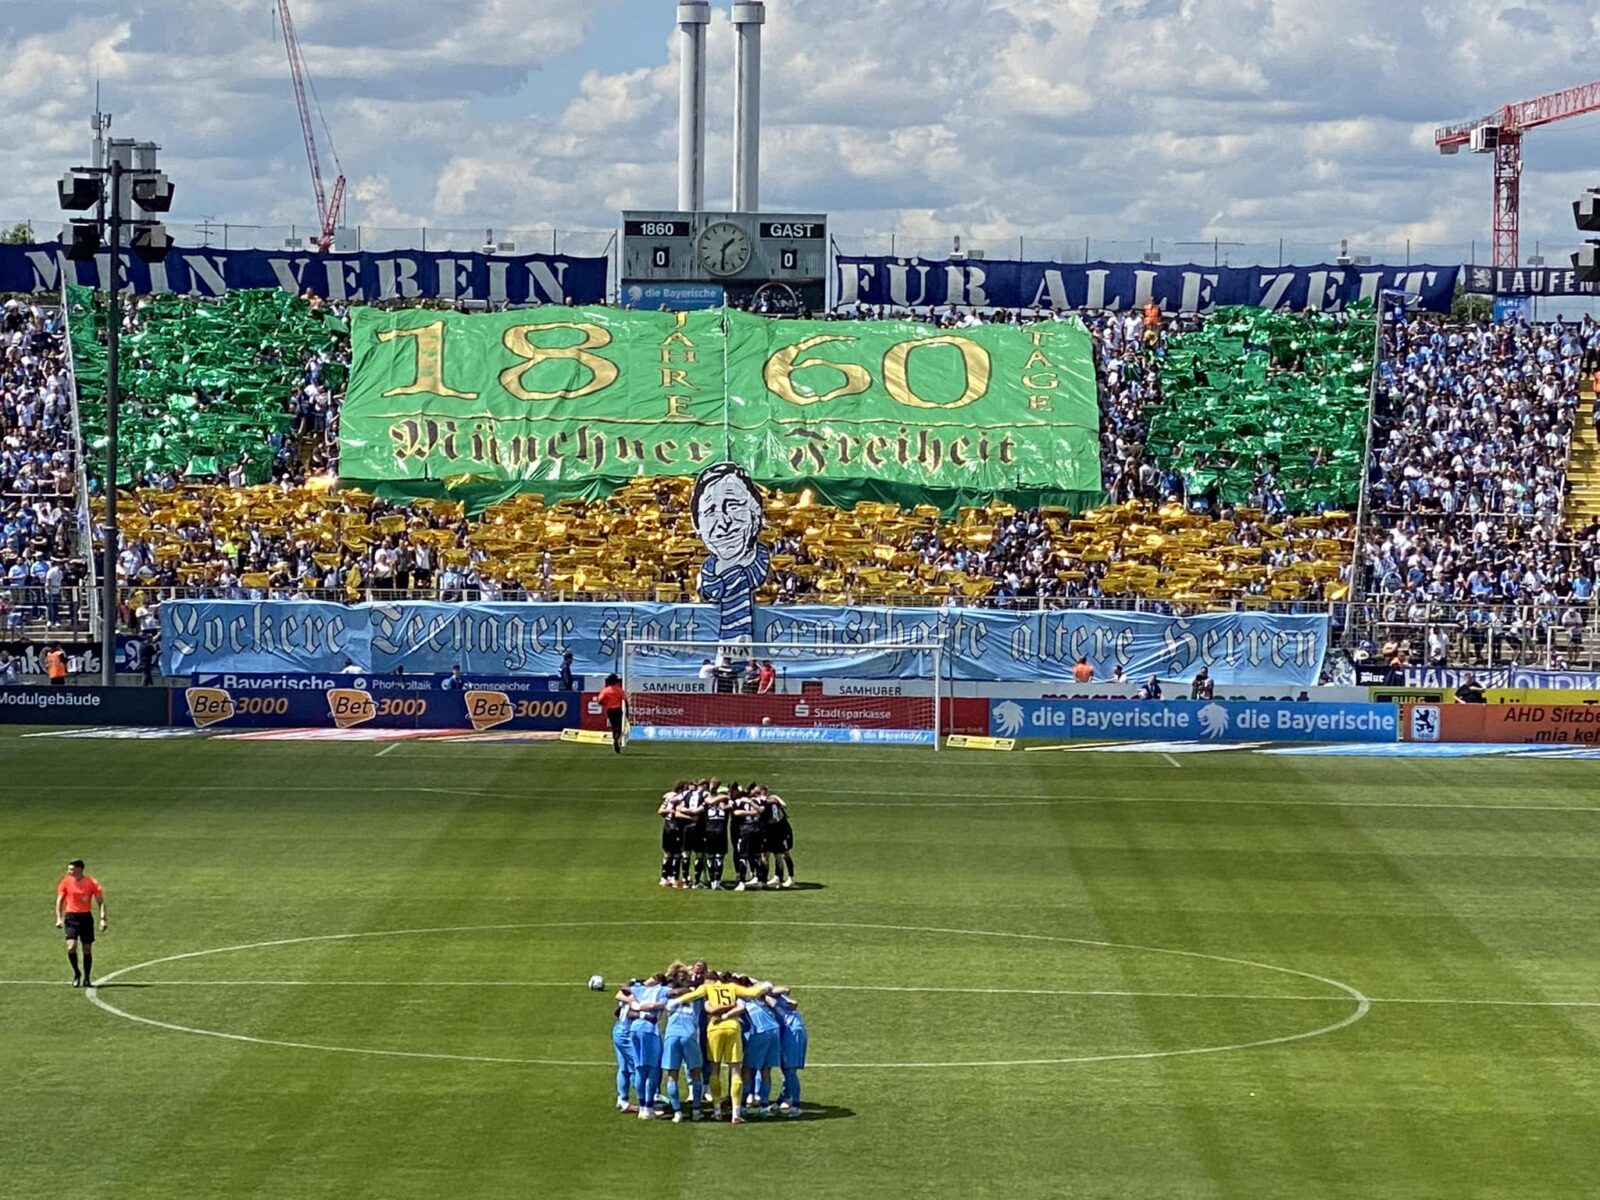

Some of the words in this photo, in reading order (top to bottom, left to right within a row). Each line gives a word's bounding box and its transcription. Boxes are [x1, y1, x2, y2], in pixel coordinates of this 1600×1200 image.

[640, 223, 674, 236] 1860
[770, 224, 814, 238] GAST
[656, 252, 665, 266] 0
[784, 253, 793, 268] 0
[25, 250, 227, 297] MEIN
[267, 257, 568, 302] VEREIN
[838, 258, 990, 307] FÜR
[1028, 269, 1219, 313] ALLE
[1258, 271, 1437, 313] ZEIT
[645, 287, 661, 298] die
[663, 288, 717, 300] Bayerische
[376, 319, 620, 401] 18
[658, 311, 699, 418] JAHRE
[762, 334, 993, 409] 60
[1020, 329, 1059, 411] TAGE
[388, 418, 713, 469] Münchner
[784, 427, 1016, 475] Freiheit
[170, 602, 346, 656] Lockere
[370, 603, 575, 671] Teenager
[1011, 611, 1134, 665] ältere
[1163, 617, 1320, 678] Herren
[642, 682, 706, 693] SAMHUBER
[839, 685, 902, 696] SAMHUBER
[193, 695, 229, 714] Bet
[236, 697, 289, 715] 3000
[335, 696, 371, 715] Bet
[377, 698, 427, 716] 3000
[473, 698, 508, 716] Bet
[515, 700, 567, 718] 3000
[814, 708, 891, 721] Stadtsparkasse
[1503, 707, 1545, 722] AHD
[1031, 707, 1065, 727] die
[1072, 708, 1189, 733] Bayerische
[1236, 710, 1270, 729] die
[1277, 710, 1395, 736] Bayerische
[714, 988, 731, 1006] 15
